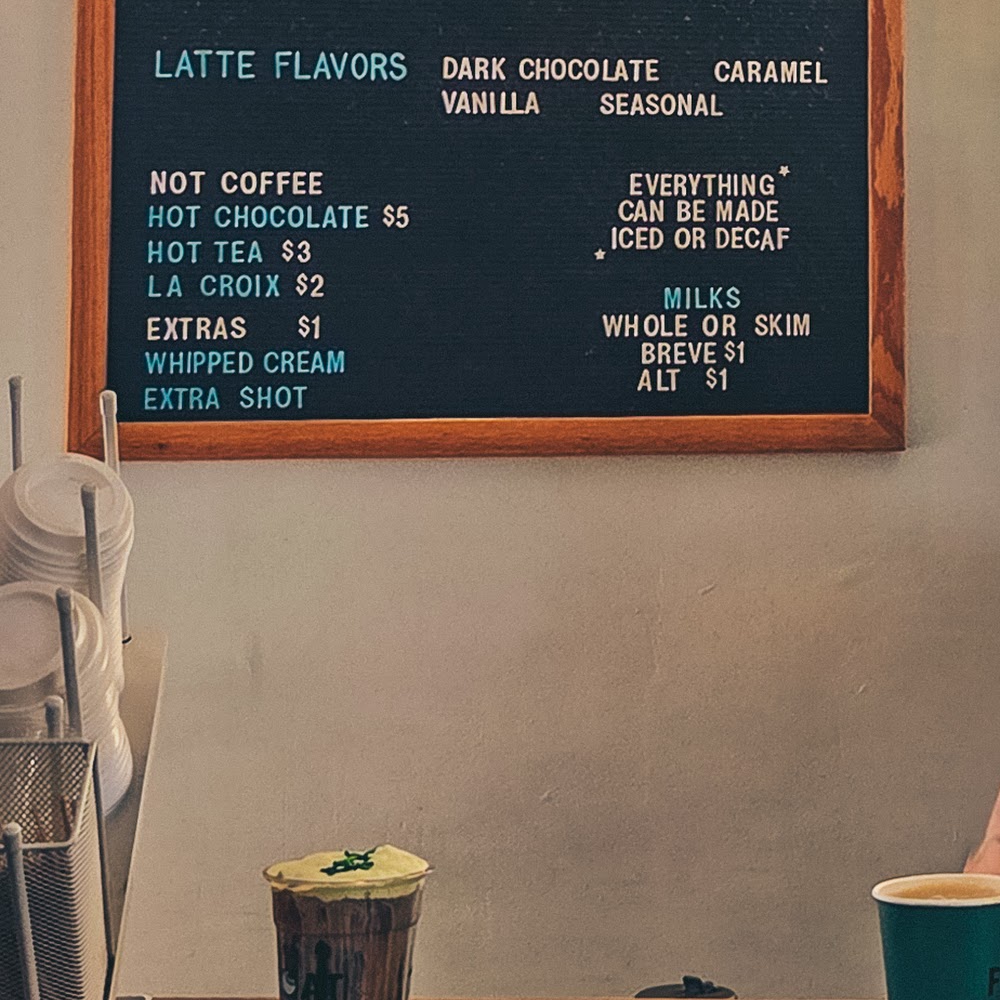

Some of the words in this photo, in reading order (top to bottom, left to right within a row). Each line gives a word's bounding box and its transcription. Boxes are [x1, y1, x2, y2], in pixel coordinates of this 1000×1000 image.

[154, 49, 256, 80] LATTE
[274, 50, 408, 82] FLAVORS
[442, 56, 506, 81] DARK
[518, 57, 660, 83] CHOCOLATE
[713, 60, 829, 84] CARAMEL
[441, 89, 540, 115] VANILLA
[599, 92, 724, 117] SEASONAL
[150, 170, 206, 196] NOT
[220, 171, 324, 196] COFFEE
[148, 205, 201, 229] HOT
[214, 204, 370, 230] CHOCOLATE
[382, 204, 410, 229] $5
[617, 199, 665, 223] CAN
[676, 199, 706, 223] BE
[715, 199, 779, 223] MADE
[147, 239, 202, 264] HOT
[213, 240, 263, 264] TEA
[281, 239, 312, 263] $3
[611, 226, 664, 250] ICED
[673, 226, 706, 250] OR
[715, 226, 791, 252] DECAF
[147, 274, 183, 298] LA
[199, 273, 280, 298] CROIX
[295, 272, 325, 298] $2
[664, 285, 741, 310] MILKS
[147, 316, 247, 341] EXTRAS
[297, 314, 321, 340] $1
[601, 313, 688, 338] WHOLE
[701, 313, 737, 337] OR
[754, 313, 810, 337] SKIM
[144, 350, 254, 375] WHIPPED
[263, 350, 345, 375] CREAM
[641, 341, 717, 365] BREVE
[724, 340, 745, 364] $1
[636, 368, 681, 392] ALT
[705, 366, 727, 391] $1
[144, 386, 220, 411] EXTRA
[239, 385, 308, 409] SHOT
